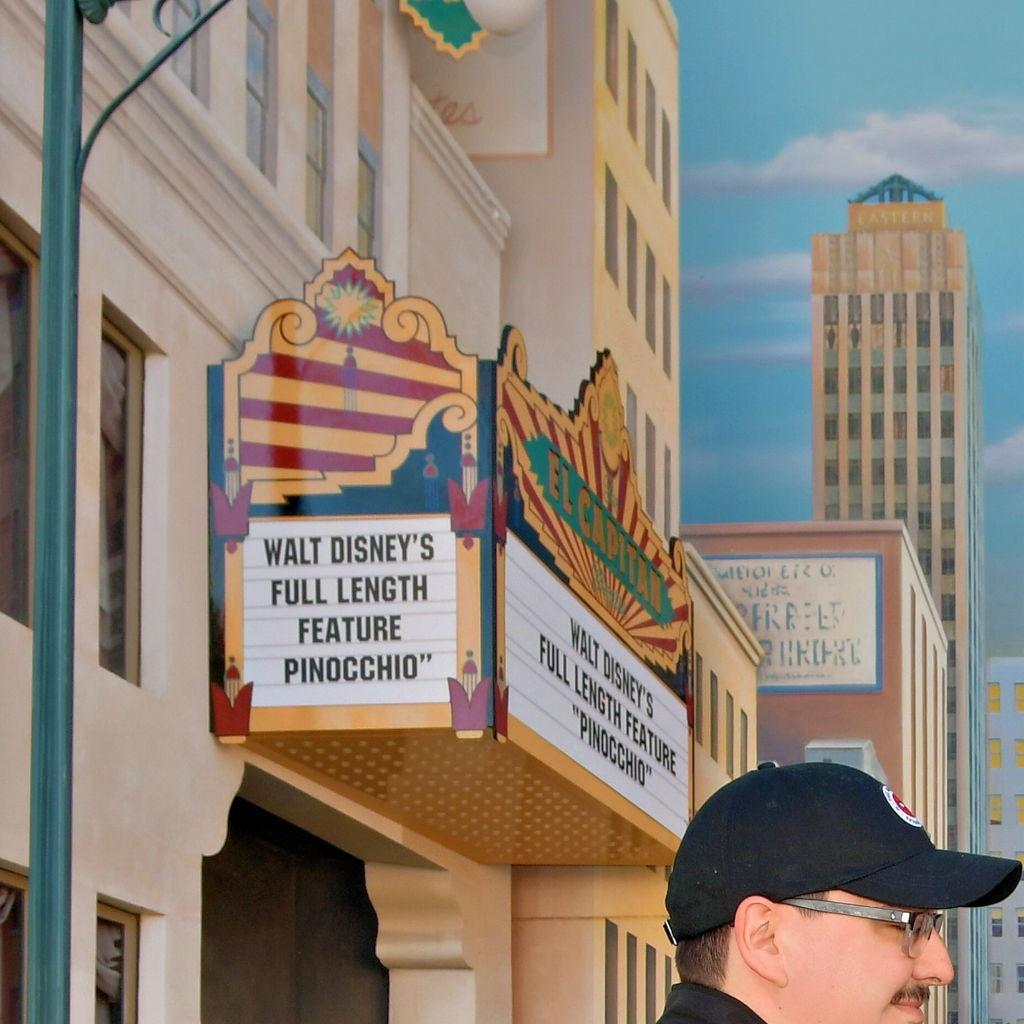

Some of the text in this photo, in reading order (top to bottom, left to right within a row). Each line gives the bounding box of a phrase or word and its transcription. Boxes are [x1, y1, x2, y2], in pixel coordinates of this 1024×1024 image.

[857, 210, 934, 226] EASTERN
[547, 448, 663, 614] EL CAPITAN
[264, 533, 435, 566] WALT DISNEY'S
[271, 574, 428, 606] FULL LENGTH
[298, 614, 402, 644] FEATURE
[570, 617, 654, 719] WALT DISNEY'S
[539, 633, 677, 776] FULL LENGTH FEATURE
